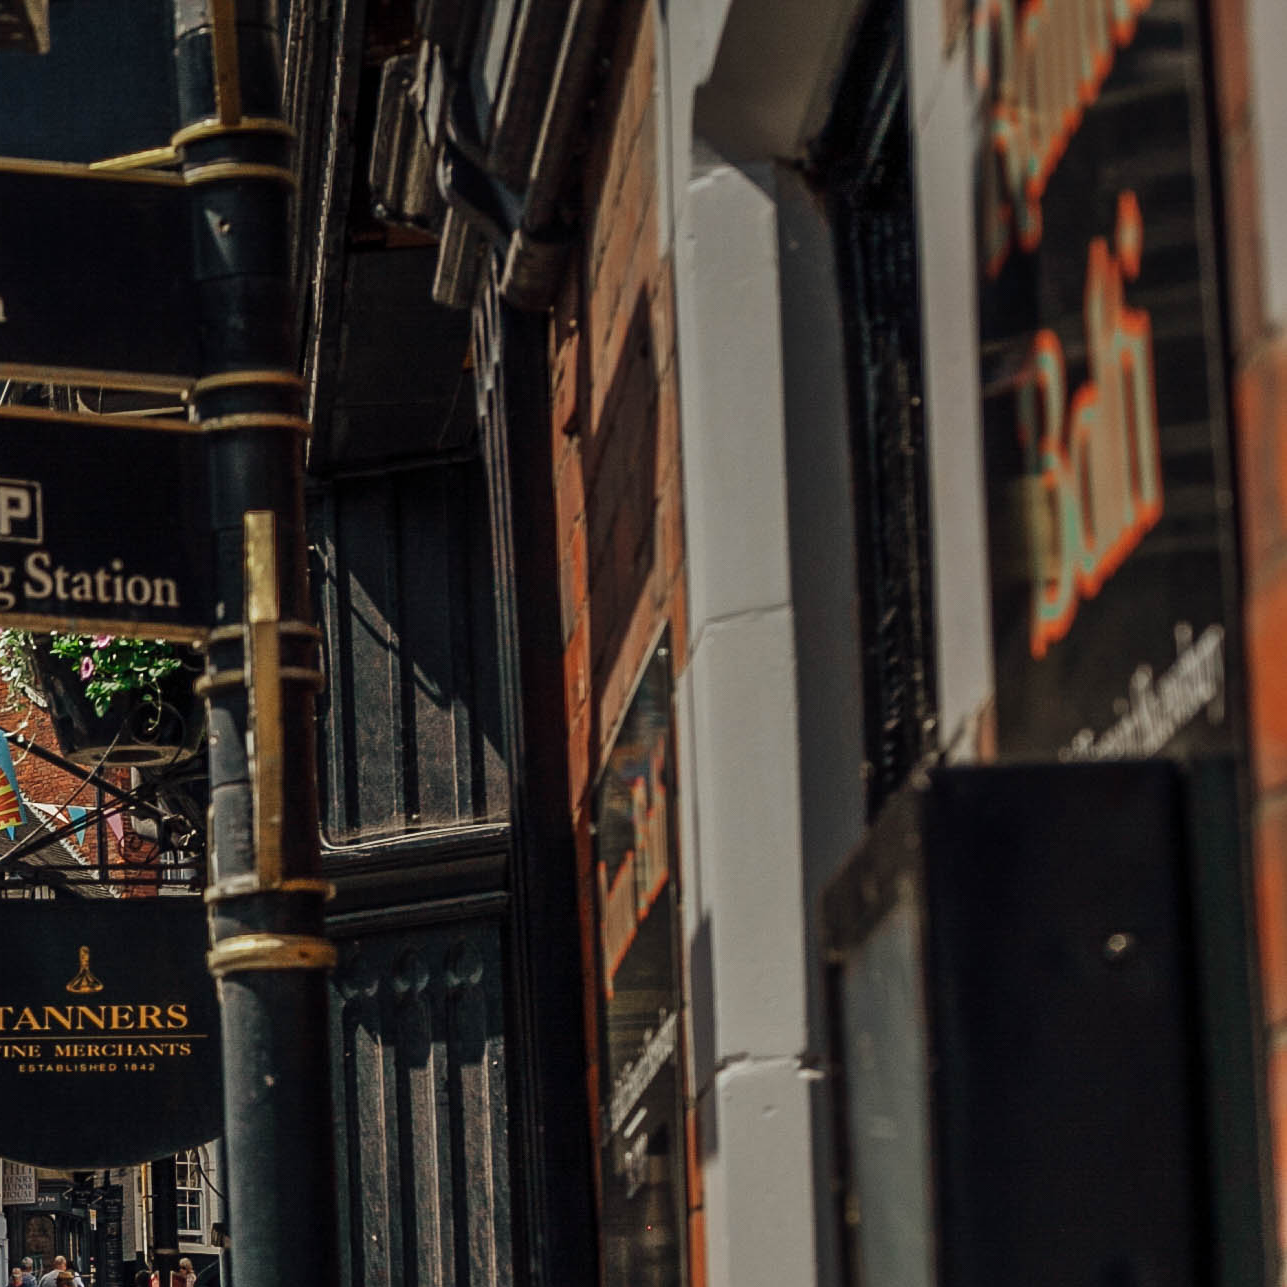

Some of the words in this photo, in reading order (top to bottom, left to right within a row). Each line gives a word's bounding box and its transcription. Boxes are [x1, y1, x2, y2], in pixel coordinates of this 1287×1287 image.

[24, 553, 180, 609] Station
[54, 1042, 192, 1058] MERCHANTS
[18, 1063, 119, 1073] ESTABLISHED
[124, 1062, 156, 1072] 1842
